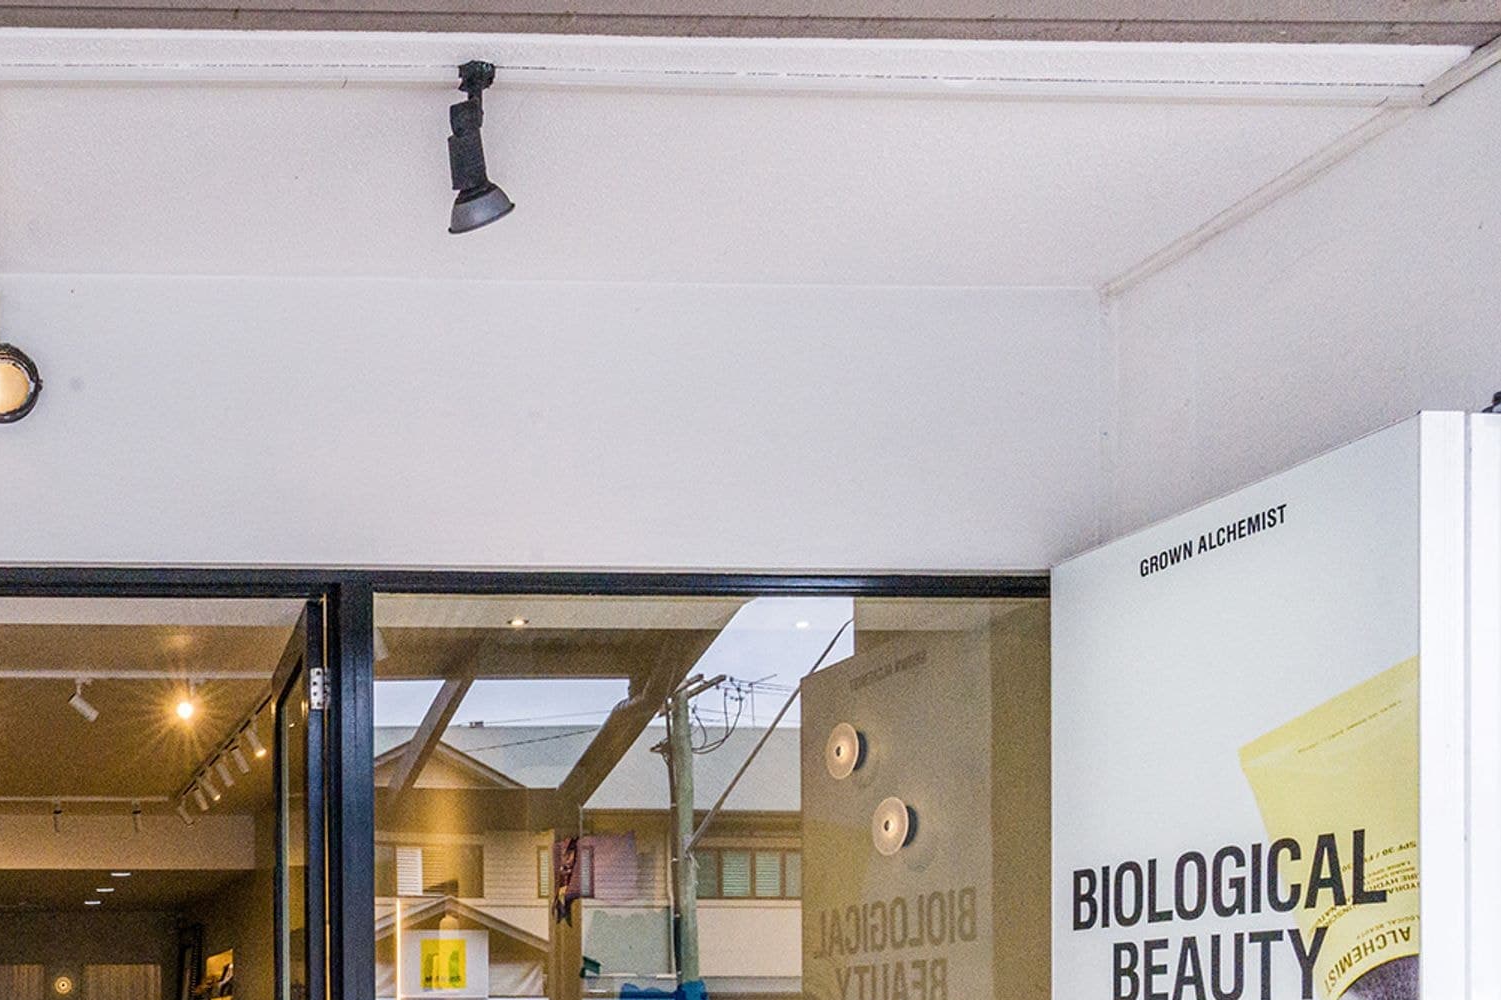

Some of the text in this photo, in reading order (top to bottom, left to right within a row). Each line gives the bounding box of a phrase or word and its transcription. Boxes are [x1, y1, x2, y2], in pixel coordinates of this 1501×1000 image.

[1139, 503, 1287, 577] GROWN ALCHEMIST
[1072, 828, 1387, 931] BIOLOGICAL
[1324, 926, 1411, 993] ALCHEMIST
